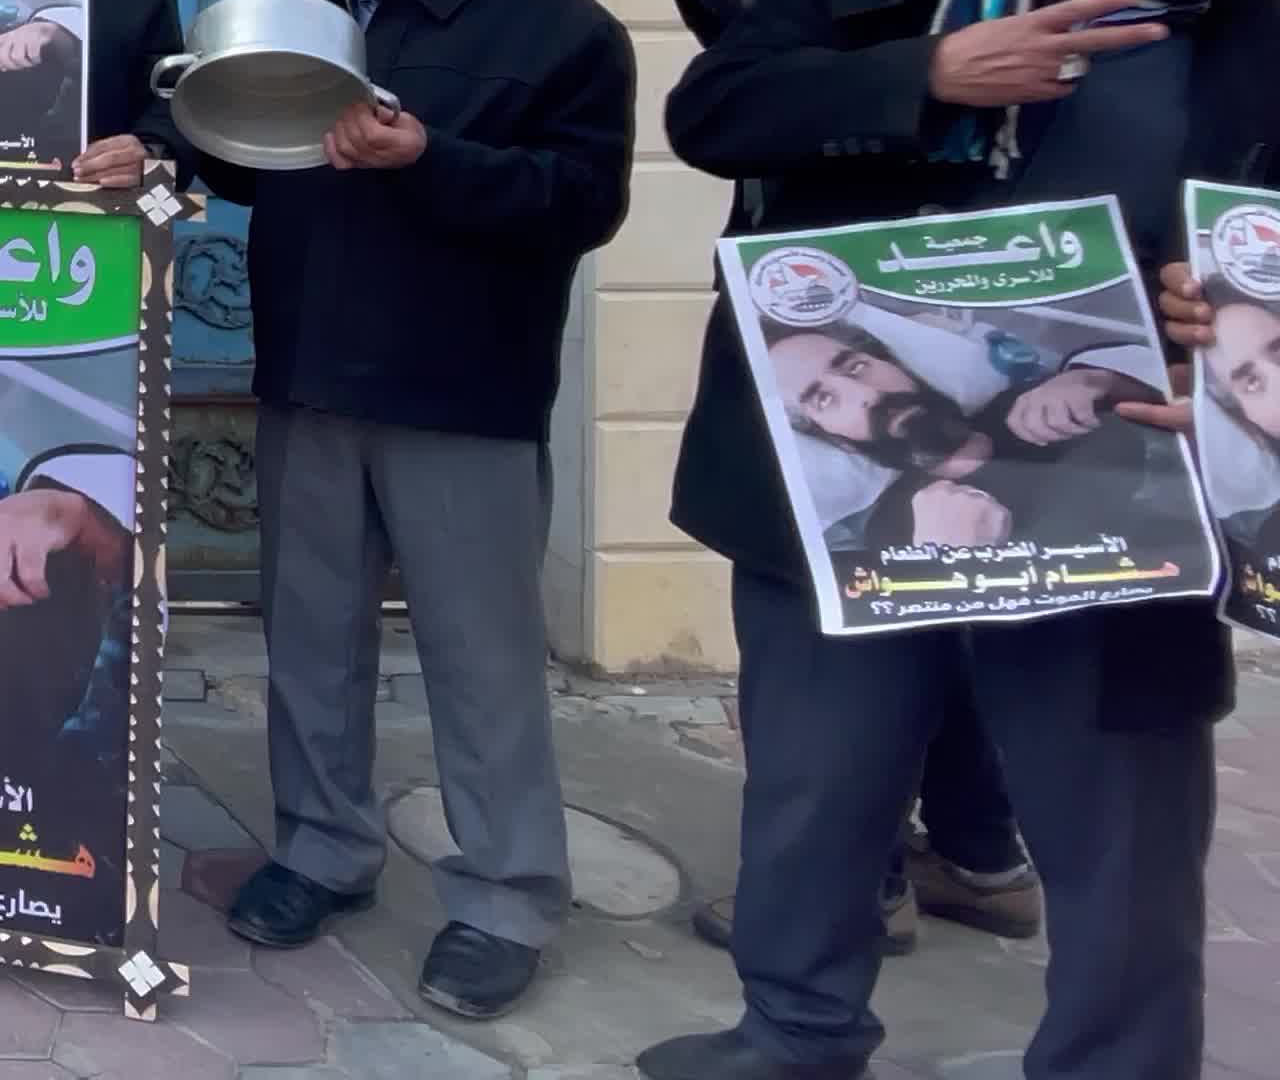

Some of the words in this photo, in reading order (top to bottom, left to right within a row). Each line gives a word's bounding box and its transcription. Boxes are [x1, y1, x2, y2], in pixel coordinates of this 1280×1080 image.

[877, 221, 1084, 272] واعد
[922, 234, 987, 252] جمعية
[845, 566, 969, 600] هواش
[973, 560, 1038, 593] أبو
[1045, 556, 1180, 590] هشام
